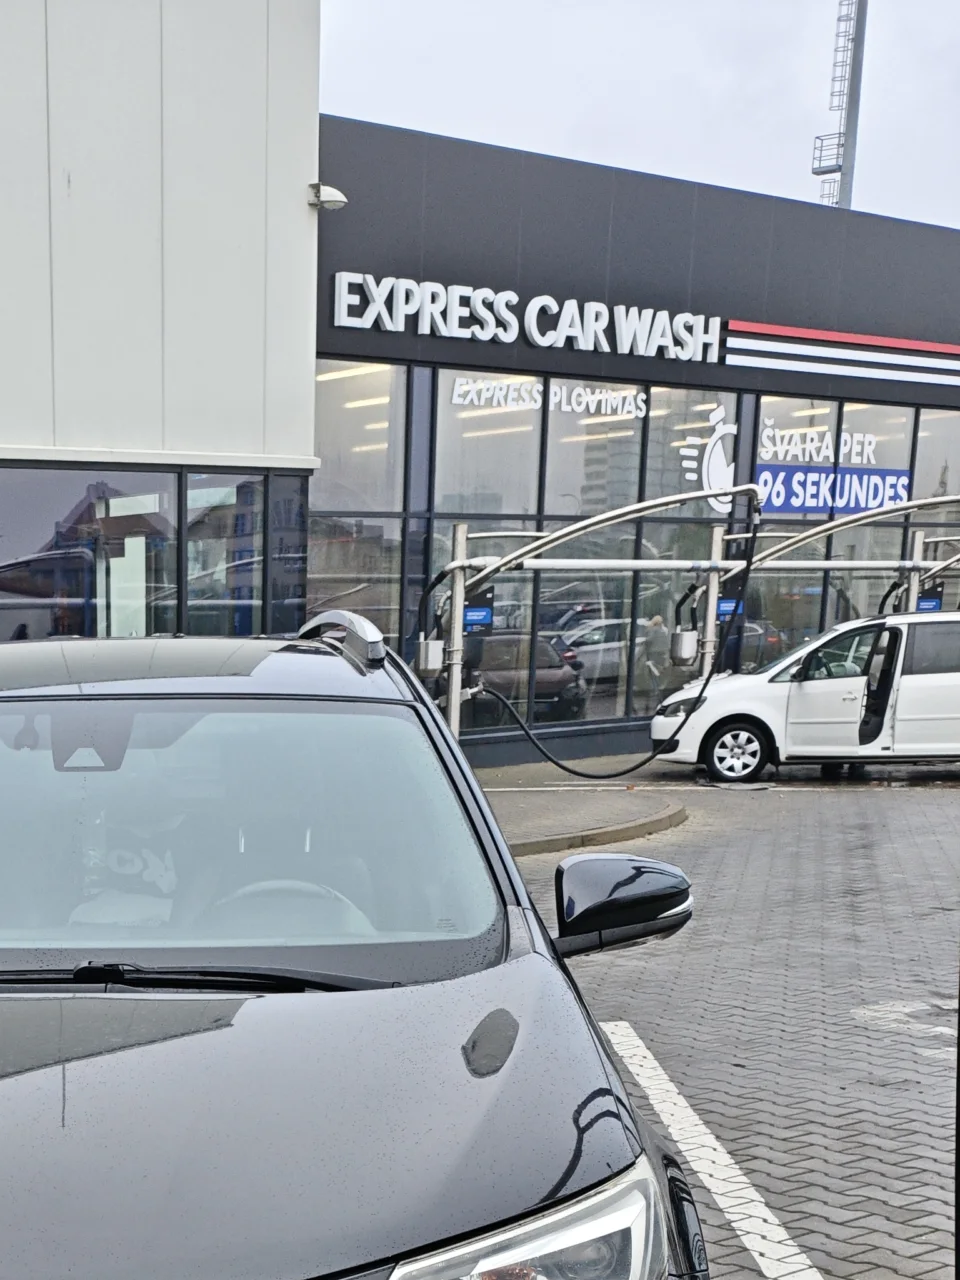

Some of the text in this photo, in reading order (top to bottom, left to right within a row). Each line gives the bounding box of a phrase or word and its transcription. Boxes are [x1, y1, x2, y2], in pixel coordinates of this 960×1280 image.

[334, 271, 721, 363] EXPRESS CAR WASH
[451, 377, 647, 418] EXPRESS PLOVIMAS
[759, 417, 877, 465] ŠVARA PER
[758, 470, 910, 509] 96 SEKUNDES
